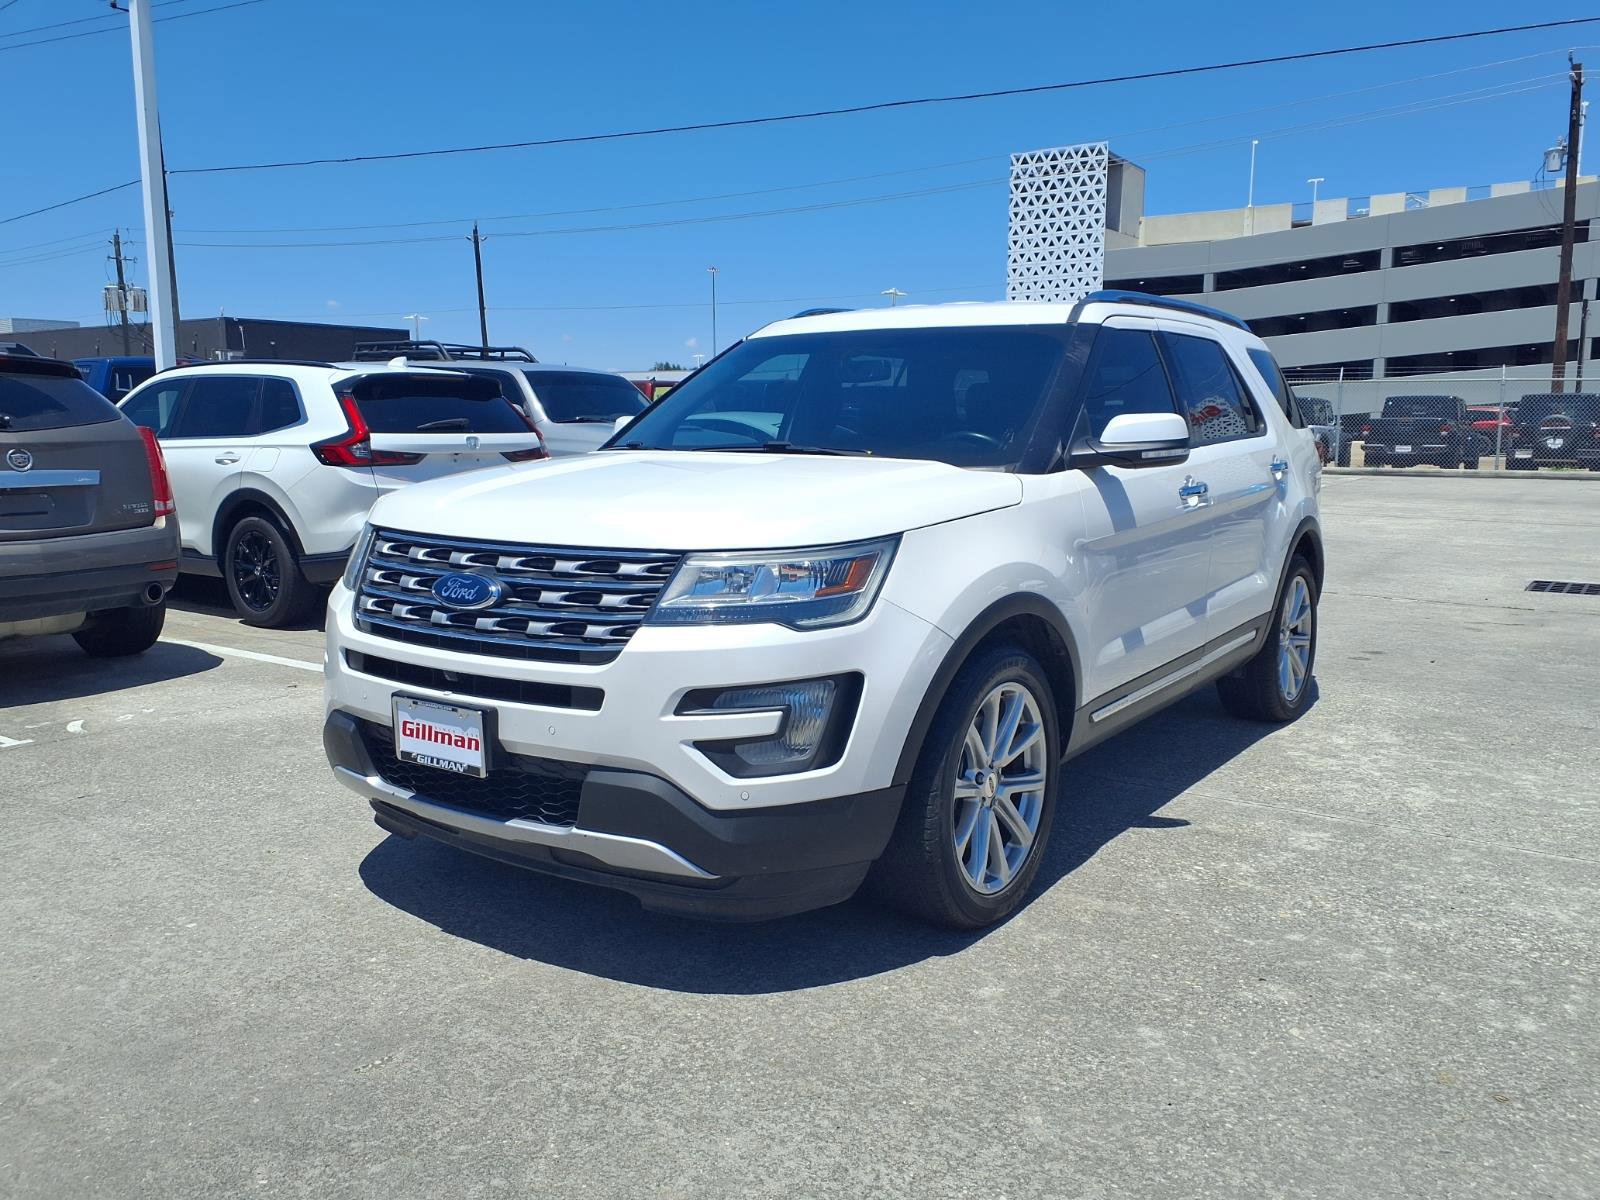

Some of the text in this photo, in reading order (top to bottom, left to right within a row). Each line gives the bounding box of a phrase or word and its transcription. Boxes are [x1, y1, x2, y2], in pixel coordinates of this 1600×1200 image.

[441, 577, 480, 600] Ford
[402, 720, 480, 752] Gillman
[416, 754, 465, 773] GILLMAN
